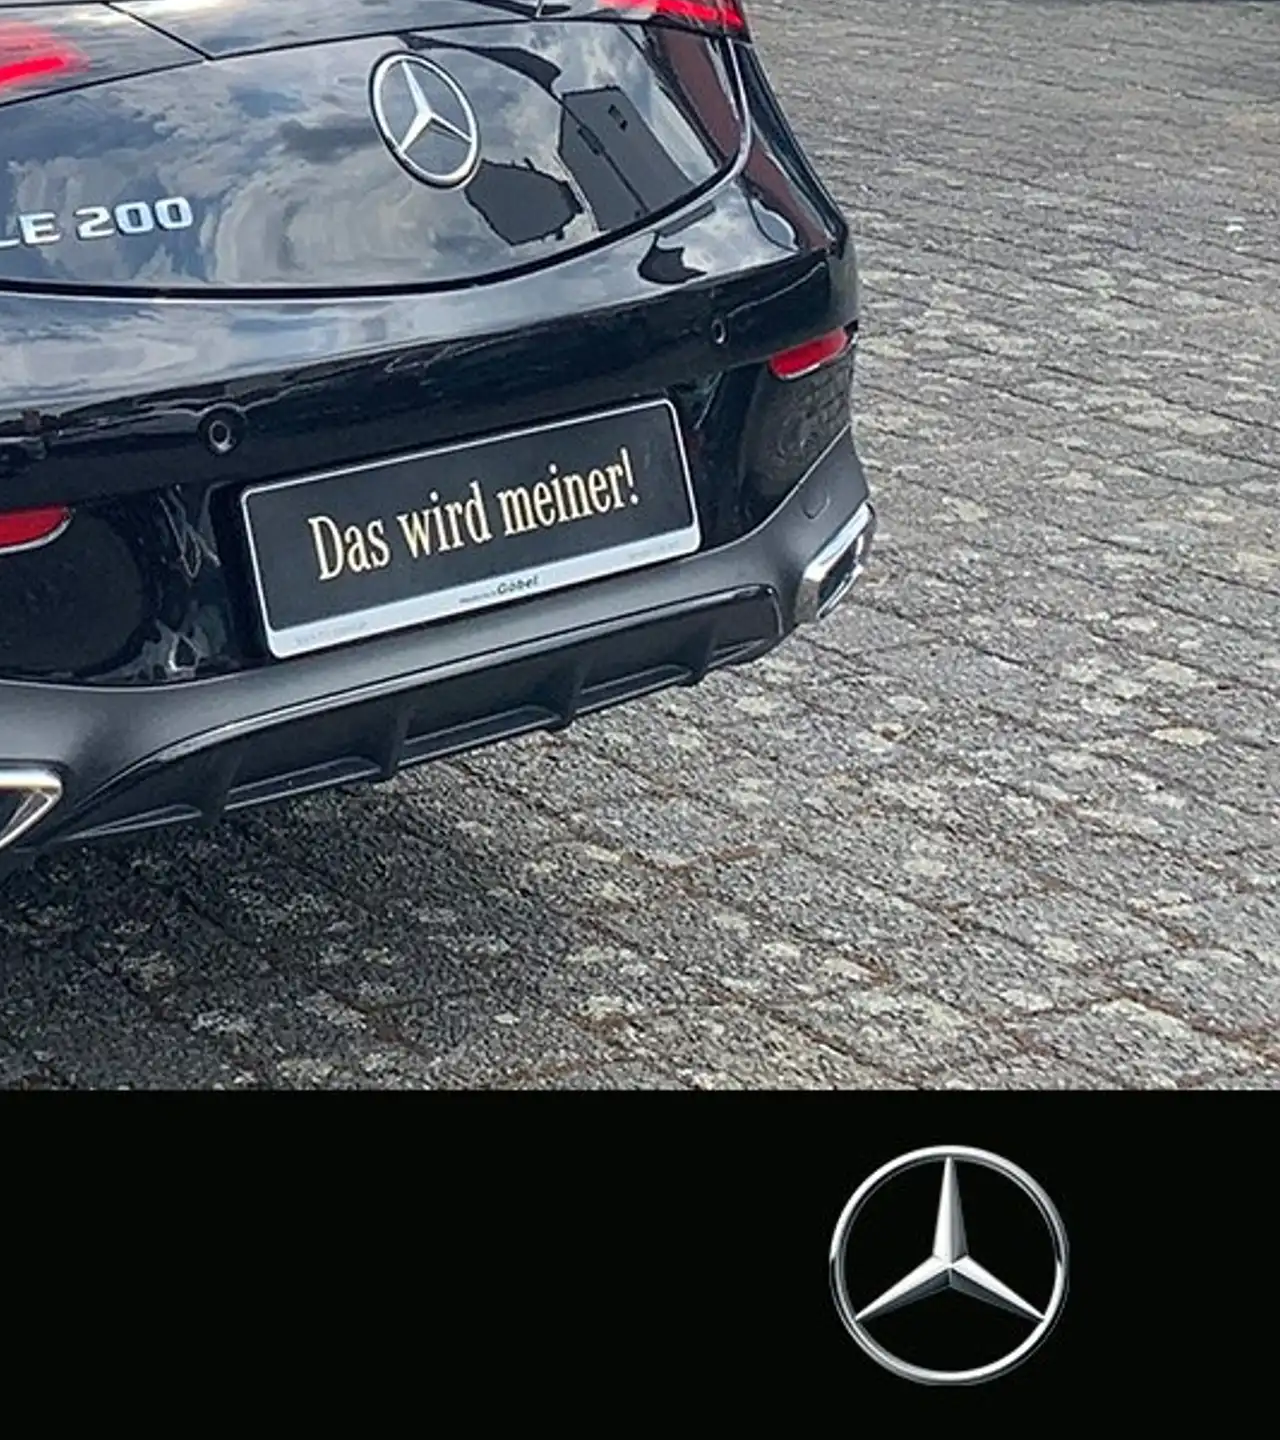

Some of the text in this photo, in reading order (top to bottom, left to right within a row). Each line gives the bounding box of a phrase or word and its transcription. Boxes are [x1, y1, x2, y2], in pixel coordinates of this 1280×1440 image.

[75, 196, 193, 240] 200
[308, 446, 641, 582] Das wird meiner!
